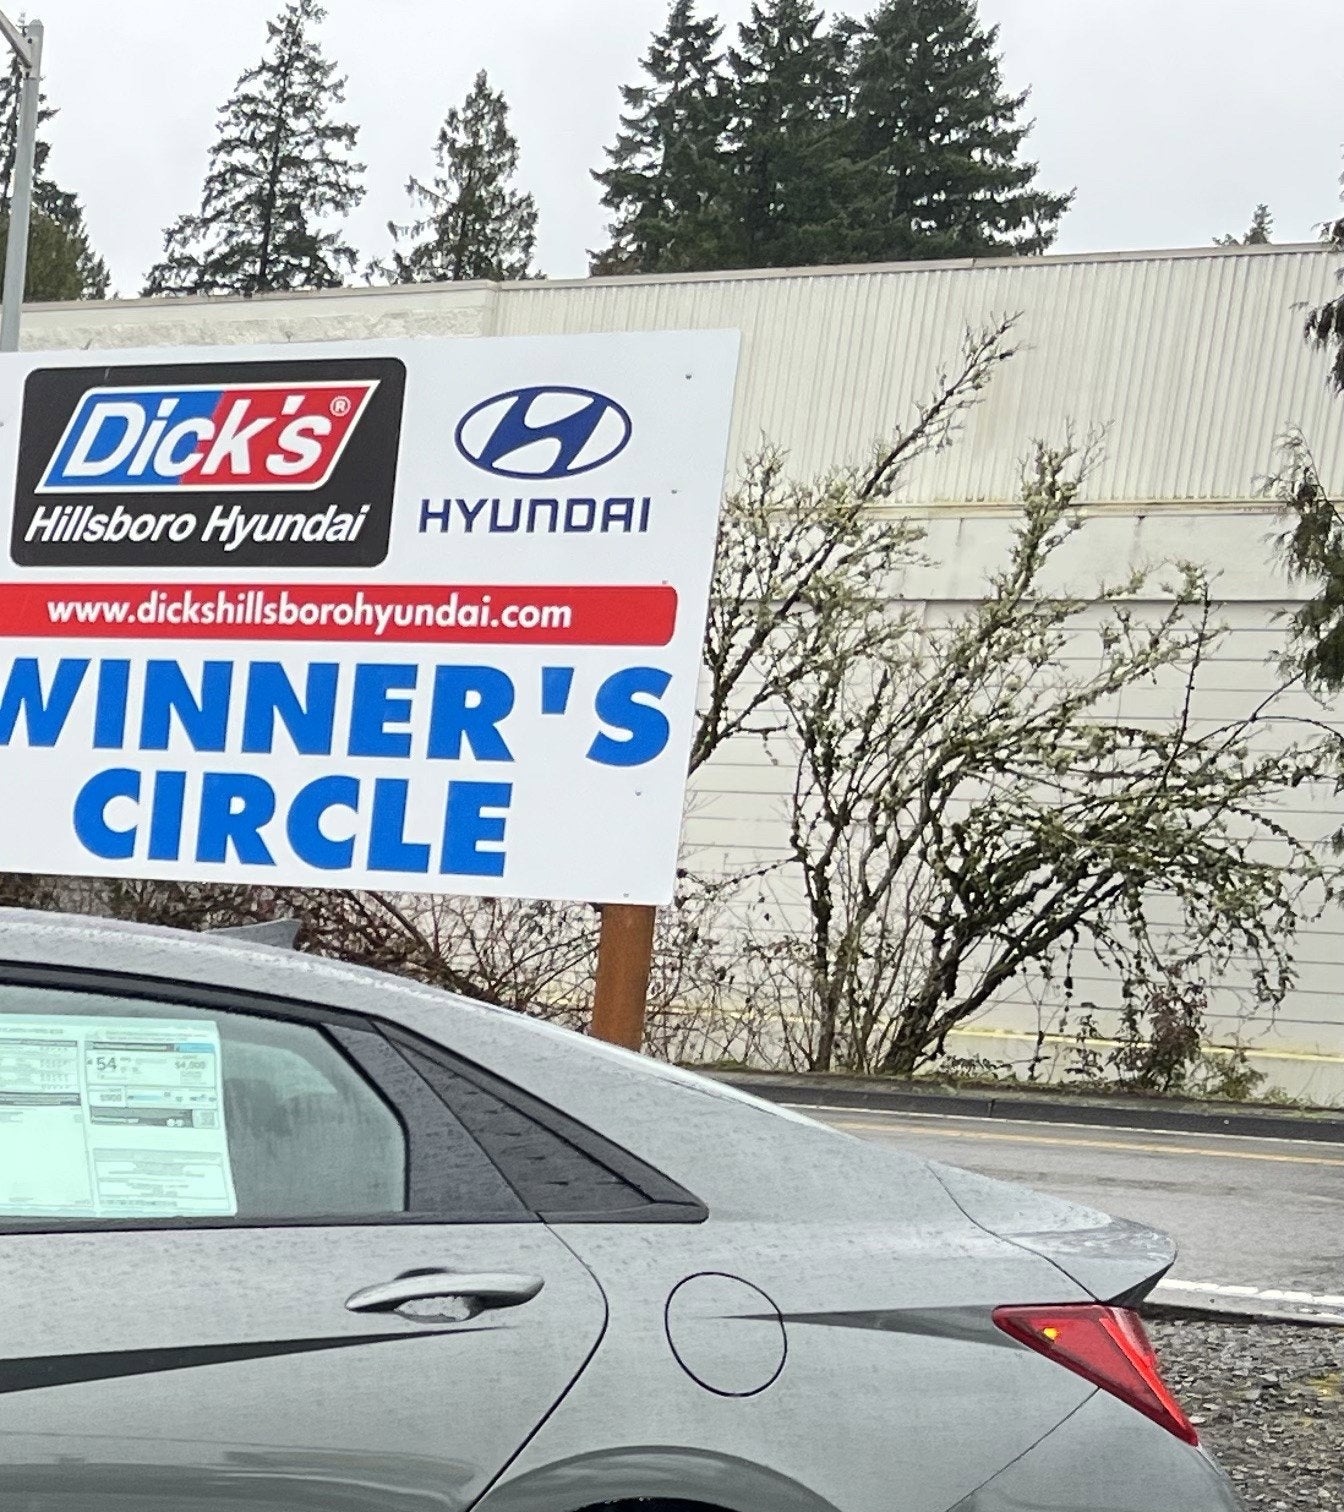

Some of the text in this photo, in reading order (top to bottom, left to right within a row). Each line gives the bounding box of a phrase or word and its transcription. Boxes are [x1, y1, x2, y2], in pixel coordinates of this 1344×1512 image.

[23, 503, 372, 552] Hillsboro Hyundai
[418, 497, 651, 534] HYUNDAI
[47, 591, 572, 634] www.dickshillsborohyundai.com
[73, 767, 514, 879] CIRCLE
